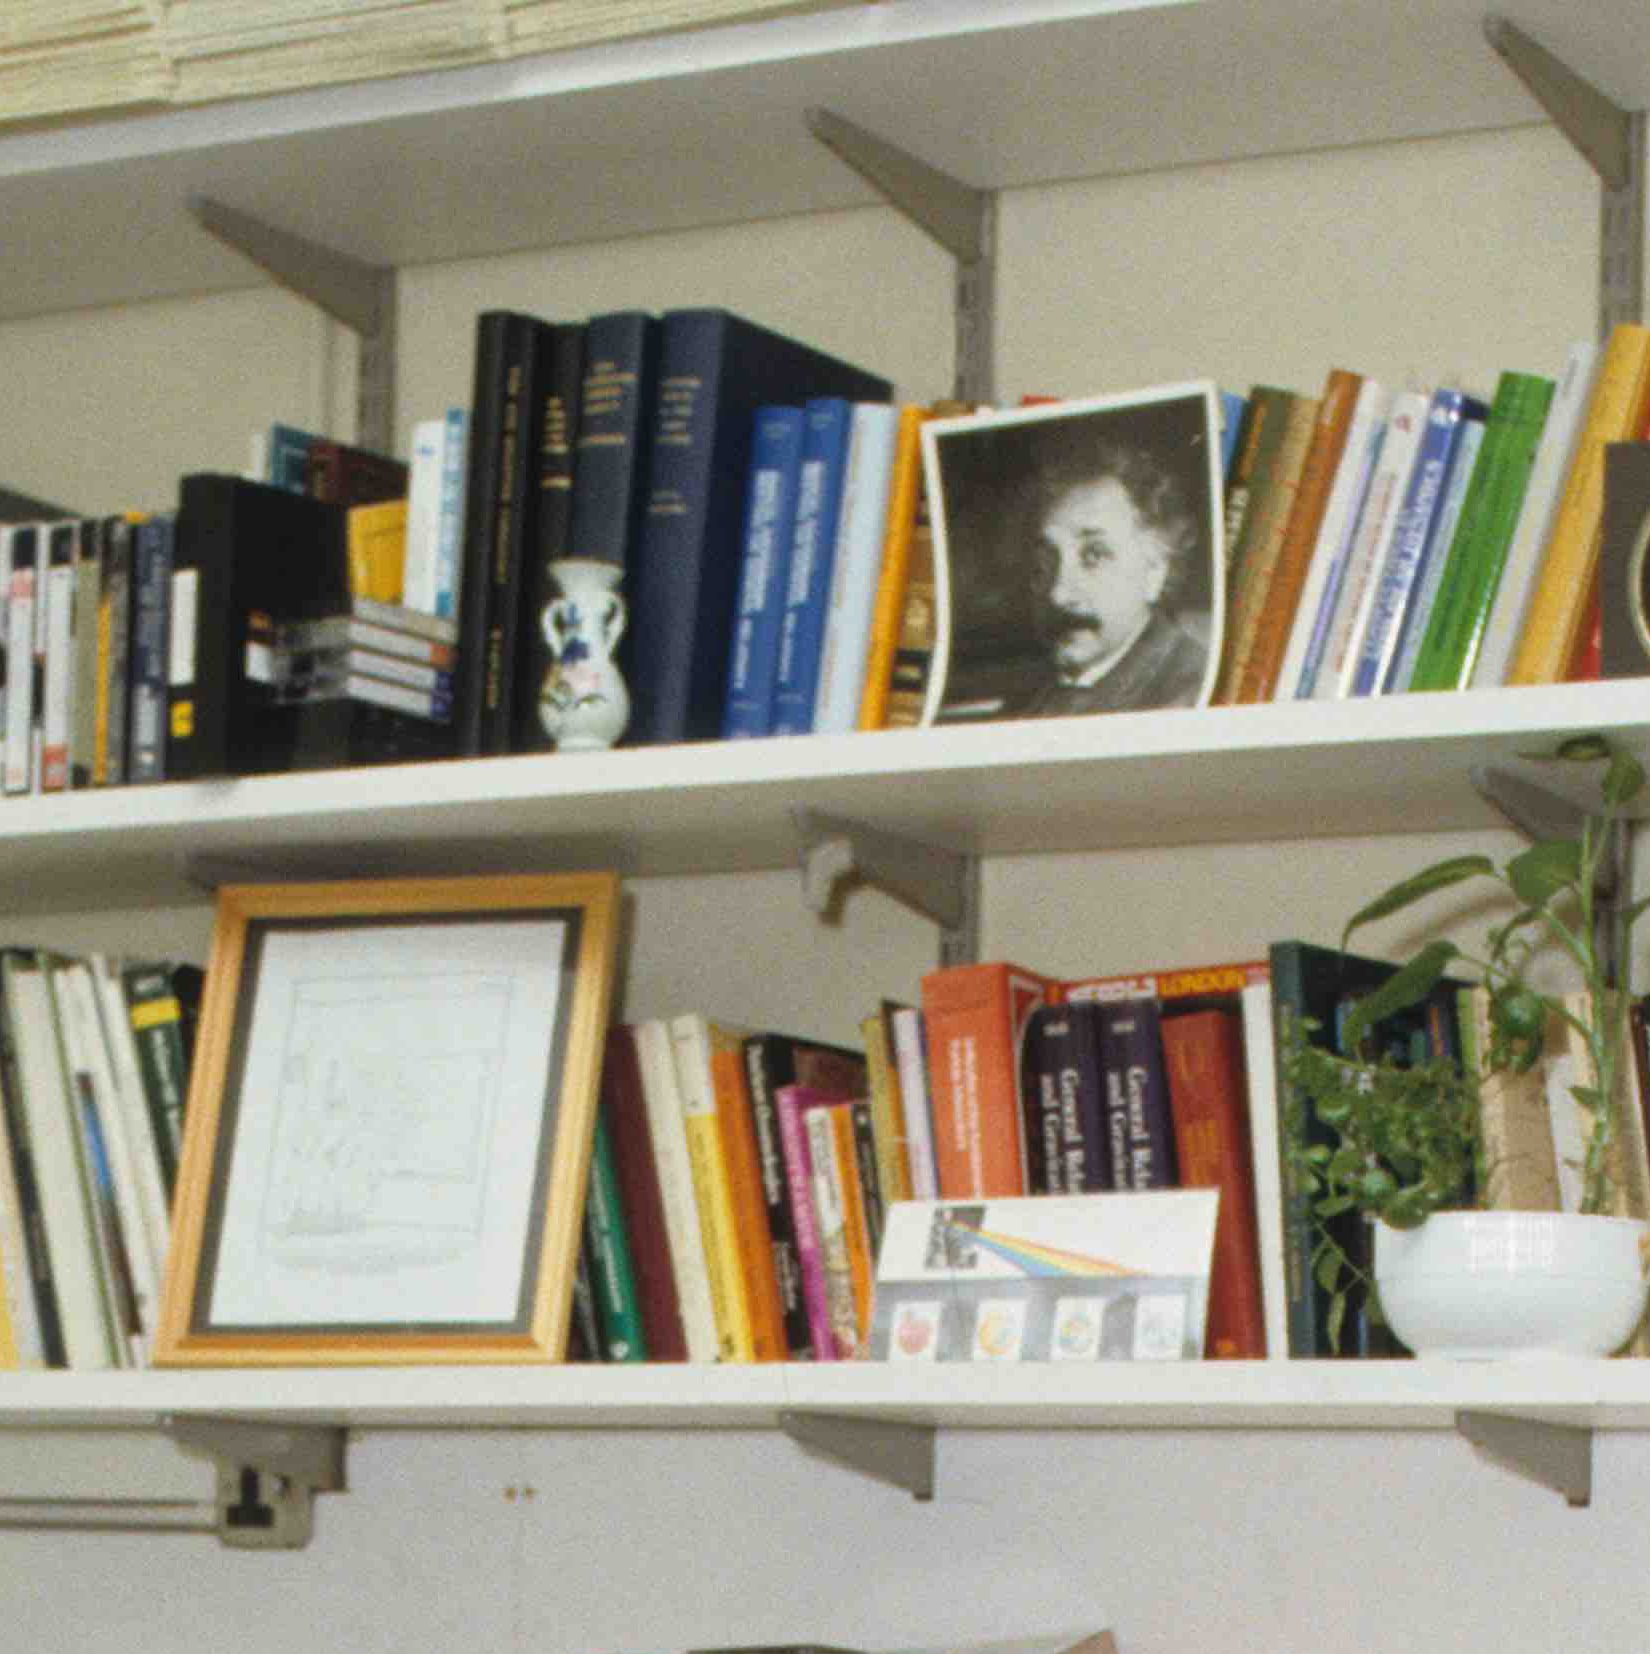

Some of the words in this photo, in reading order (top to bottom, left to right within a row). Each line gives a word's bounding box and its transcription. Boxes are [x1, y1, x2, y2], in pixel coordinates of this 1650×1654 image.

[1041, 1073, 1061, 1109] and
[1061, 1067, 1084, 1142] General
[1107, 1071, 1128, 1107] and
[1127, 1065, 1151, 1140] General
